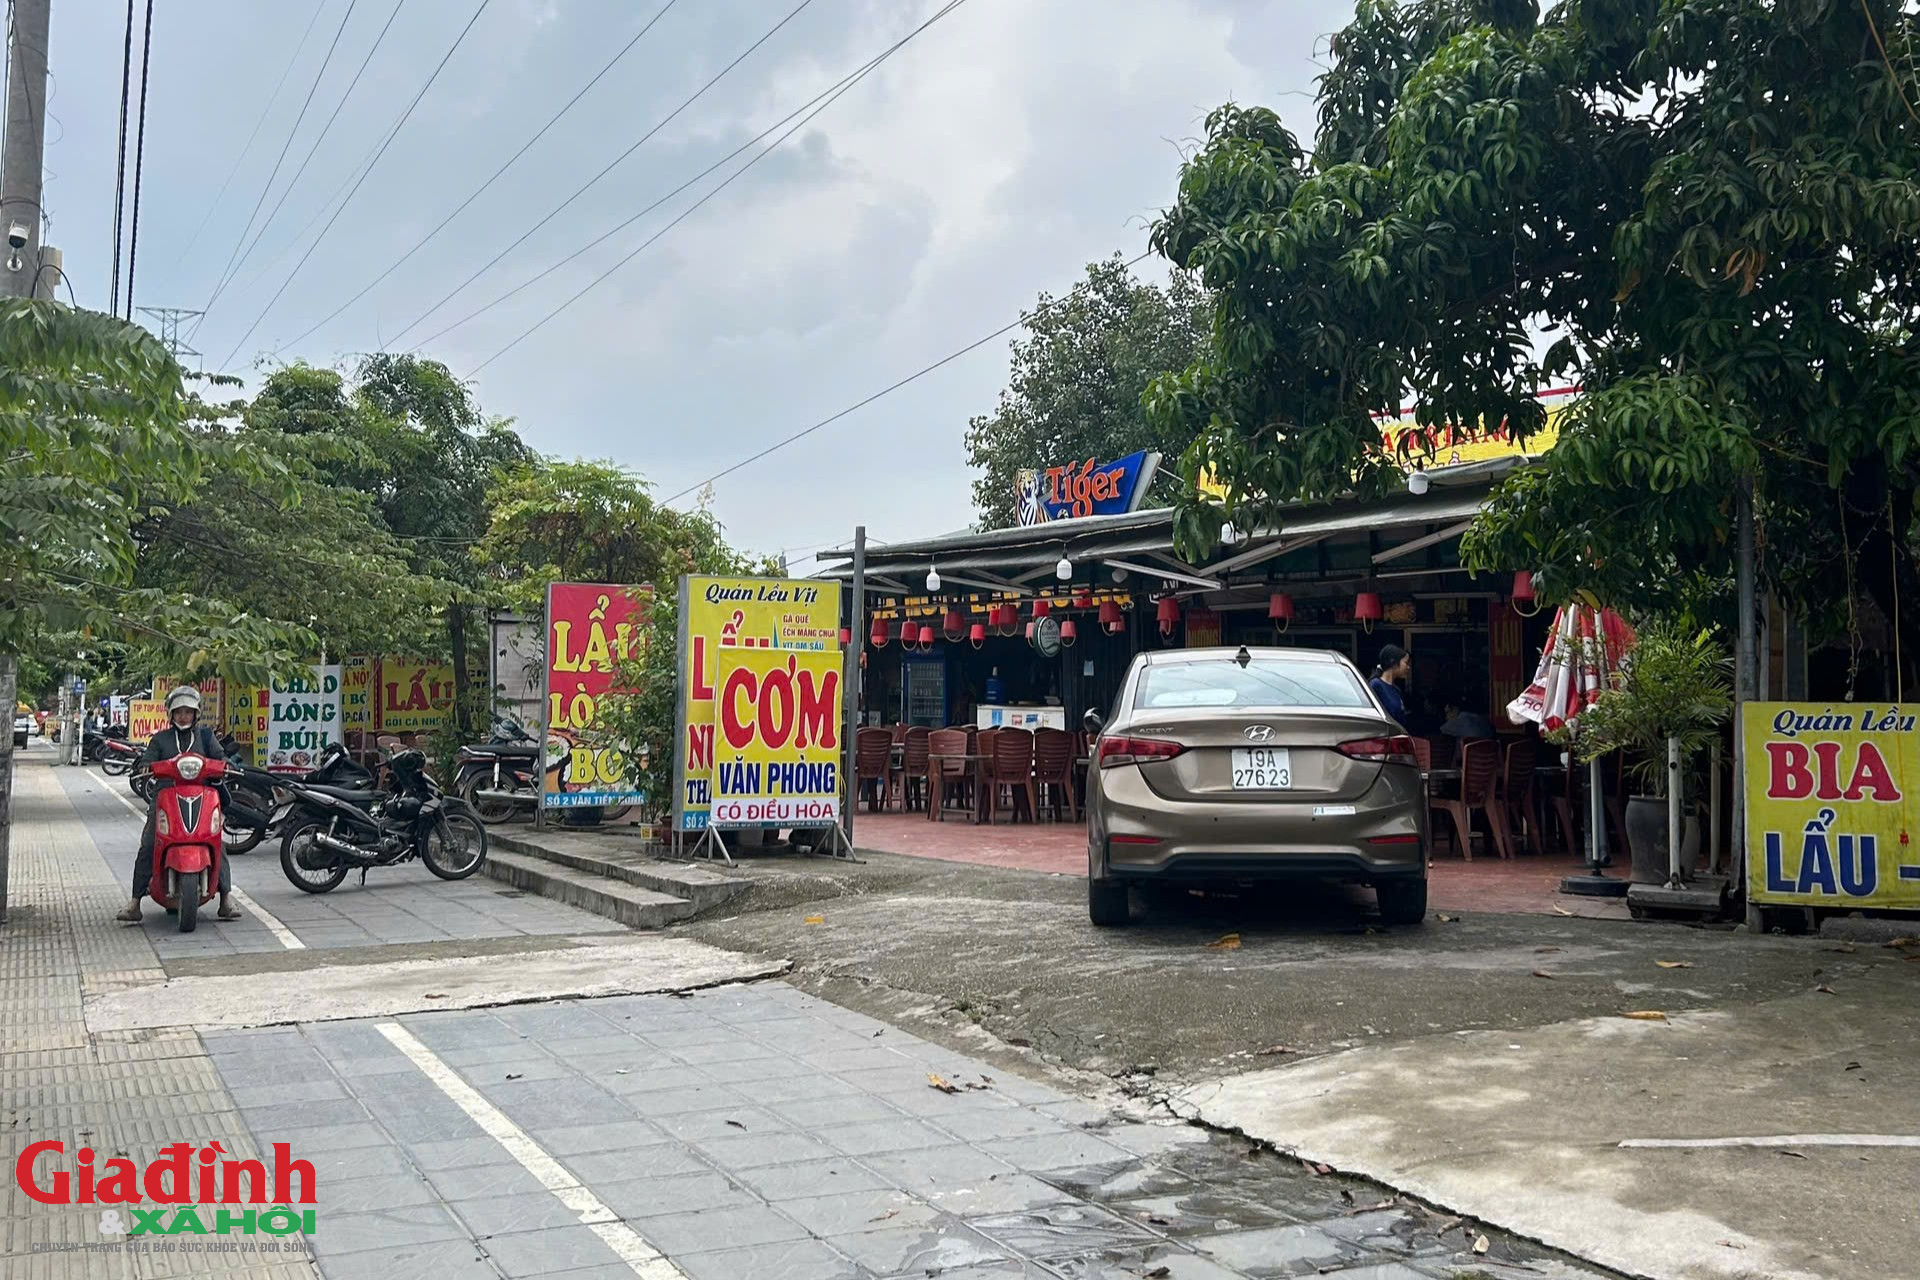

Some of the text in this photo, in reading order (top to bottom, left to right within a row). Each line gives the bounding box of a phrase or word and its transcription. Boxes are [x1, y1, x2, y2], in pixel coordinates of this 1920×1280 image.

[1046, 457, 1124, 518] Tiger
[706, 584, 818, 607] Quán Lều Vịt
[272, 697, 337, 721] LÒNG
[722, 654, 839, 749] CƠM
[1773, 706, 1916, 737] Quán Lều
[278, 726, 329, 750] BÚN
[1247, 749, 1276, 767] 19A
[720, 755, 836, 794] VĂN PHÒNG
[1235, 769, 1289, 786] 276.23
[1765, 742, 1901, 800] BIA
[562, 797, 569, 805] 2
[717, 799, 833, 820] CÓ ĐIỀU HÒA
[686, 813, 696, 828] SỐ
[698, 816, 703, 827] 2
[1766, 808, 1877, 896] LẨU
